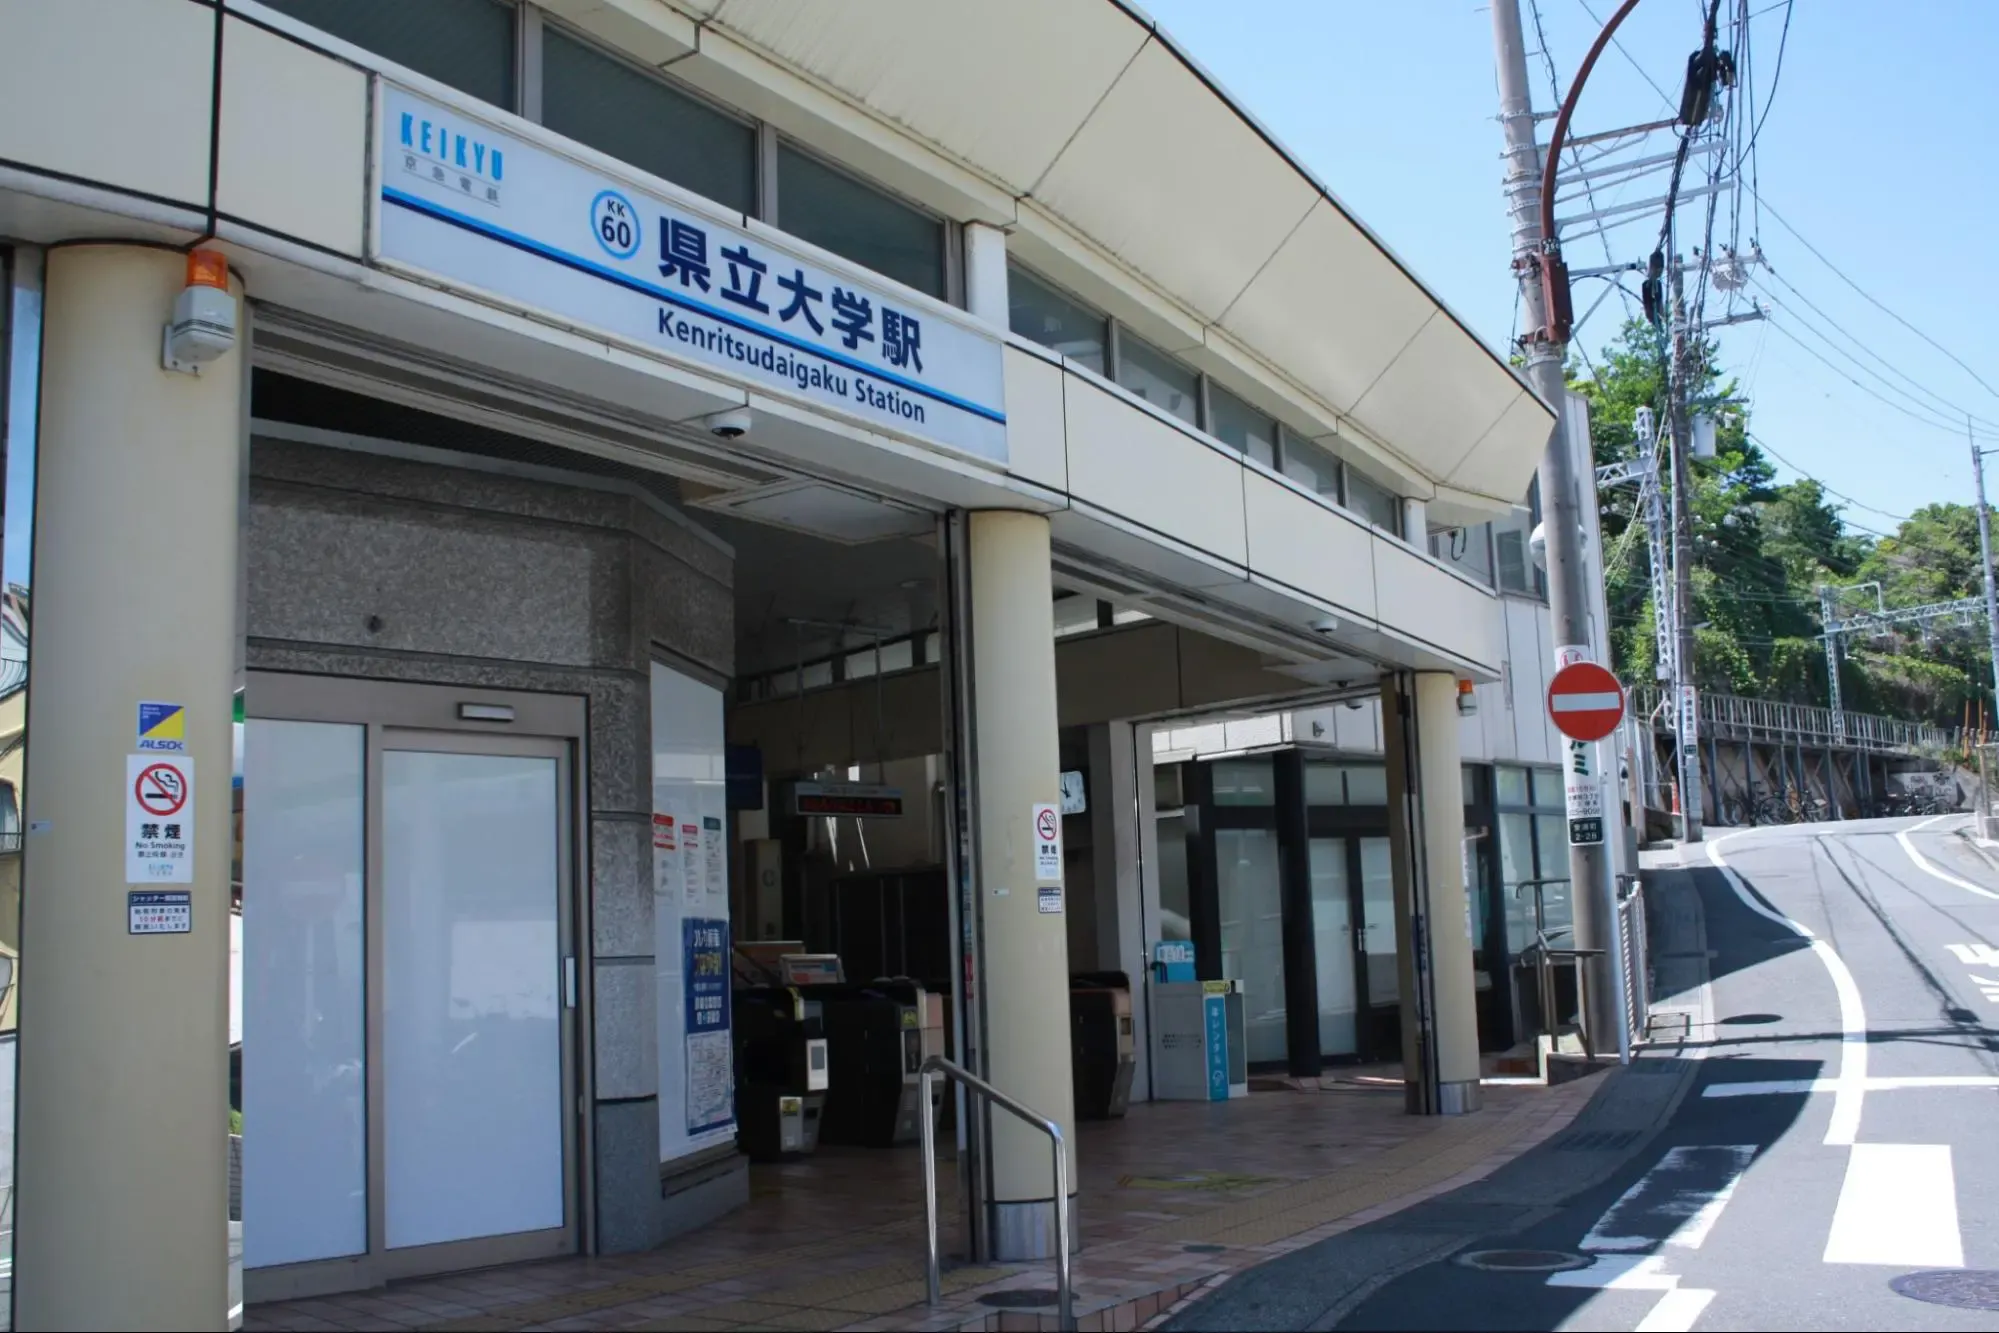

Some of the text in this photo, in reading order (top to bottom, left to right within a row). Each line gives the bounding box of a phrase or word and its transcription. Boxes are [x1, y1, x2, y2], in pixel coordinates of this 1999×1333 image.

[401, 111, 502, 181] KEIKYU
[606, 199, 625, 218] KK
[601, 215, 631, 248] 60
[658, 215, 923, 374] 県立大学駅
[659, 307, 925, 424] Kenritsudaigaku Station
[139, 740, 184, 750] ALSOK
[141, 823, 181, 839] 禁煙
[135, 841, 185, 851] No Smoking
